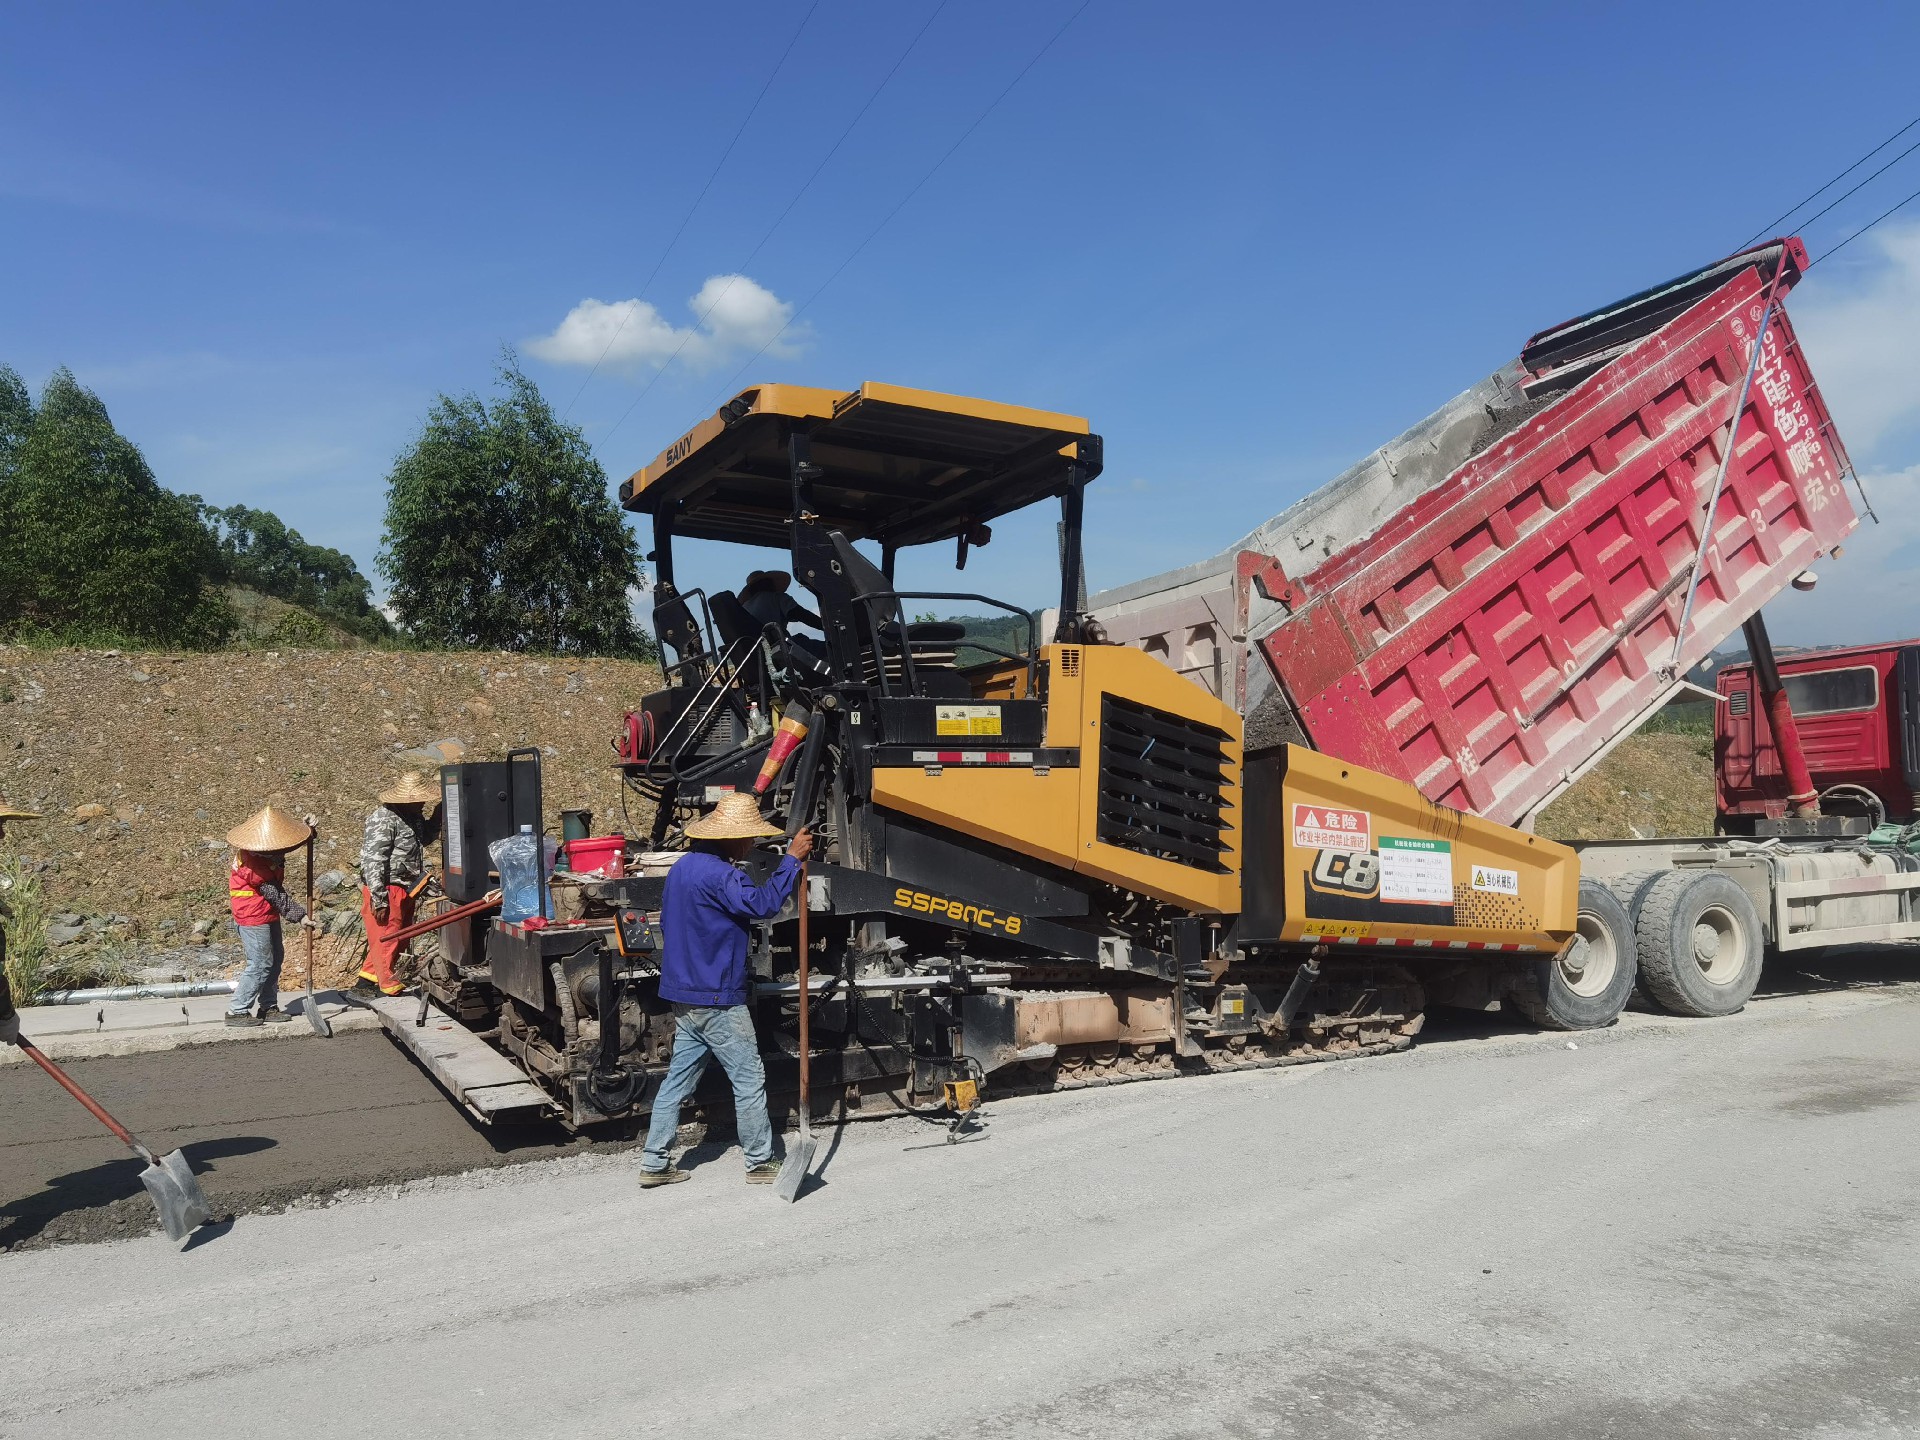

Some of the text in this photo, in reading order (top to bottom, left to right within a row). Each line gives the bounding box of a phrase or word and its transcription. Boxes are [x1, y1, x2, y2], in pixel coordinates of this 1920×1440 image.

[666, 433, 693, 468] SANY
[1325, 811, 1358, 830] 危险
[1299, 830, 1364, 848] 作业半径内禁止靠近
[1315, 849, 1380, 890] C8
[893, 887, 1022, 936] SSP80C-8
